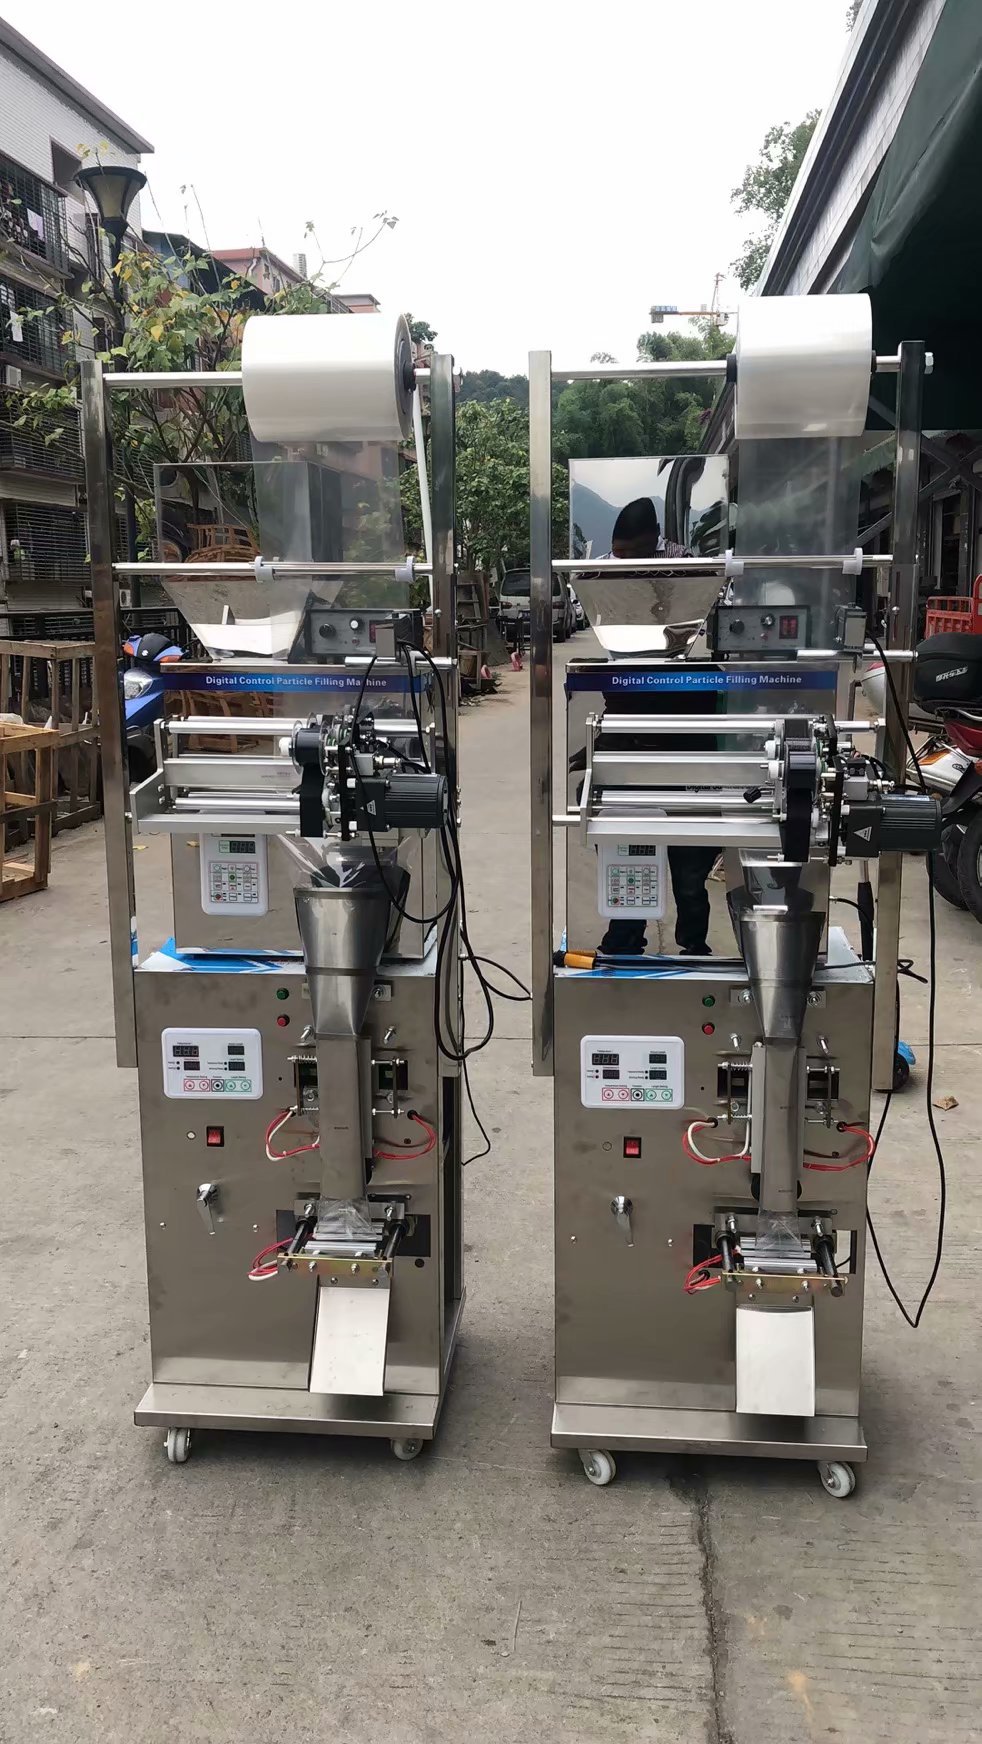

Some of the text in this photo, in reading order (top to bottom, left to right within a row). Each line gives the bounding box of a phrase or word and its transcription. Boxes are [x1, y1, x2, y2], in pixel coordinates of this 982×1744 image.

[205, 676, 387, 688] Digital Control Particle Filling Mahine
[612, 675, 802, 687] Digital Control Particle Filling Machine
